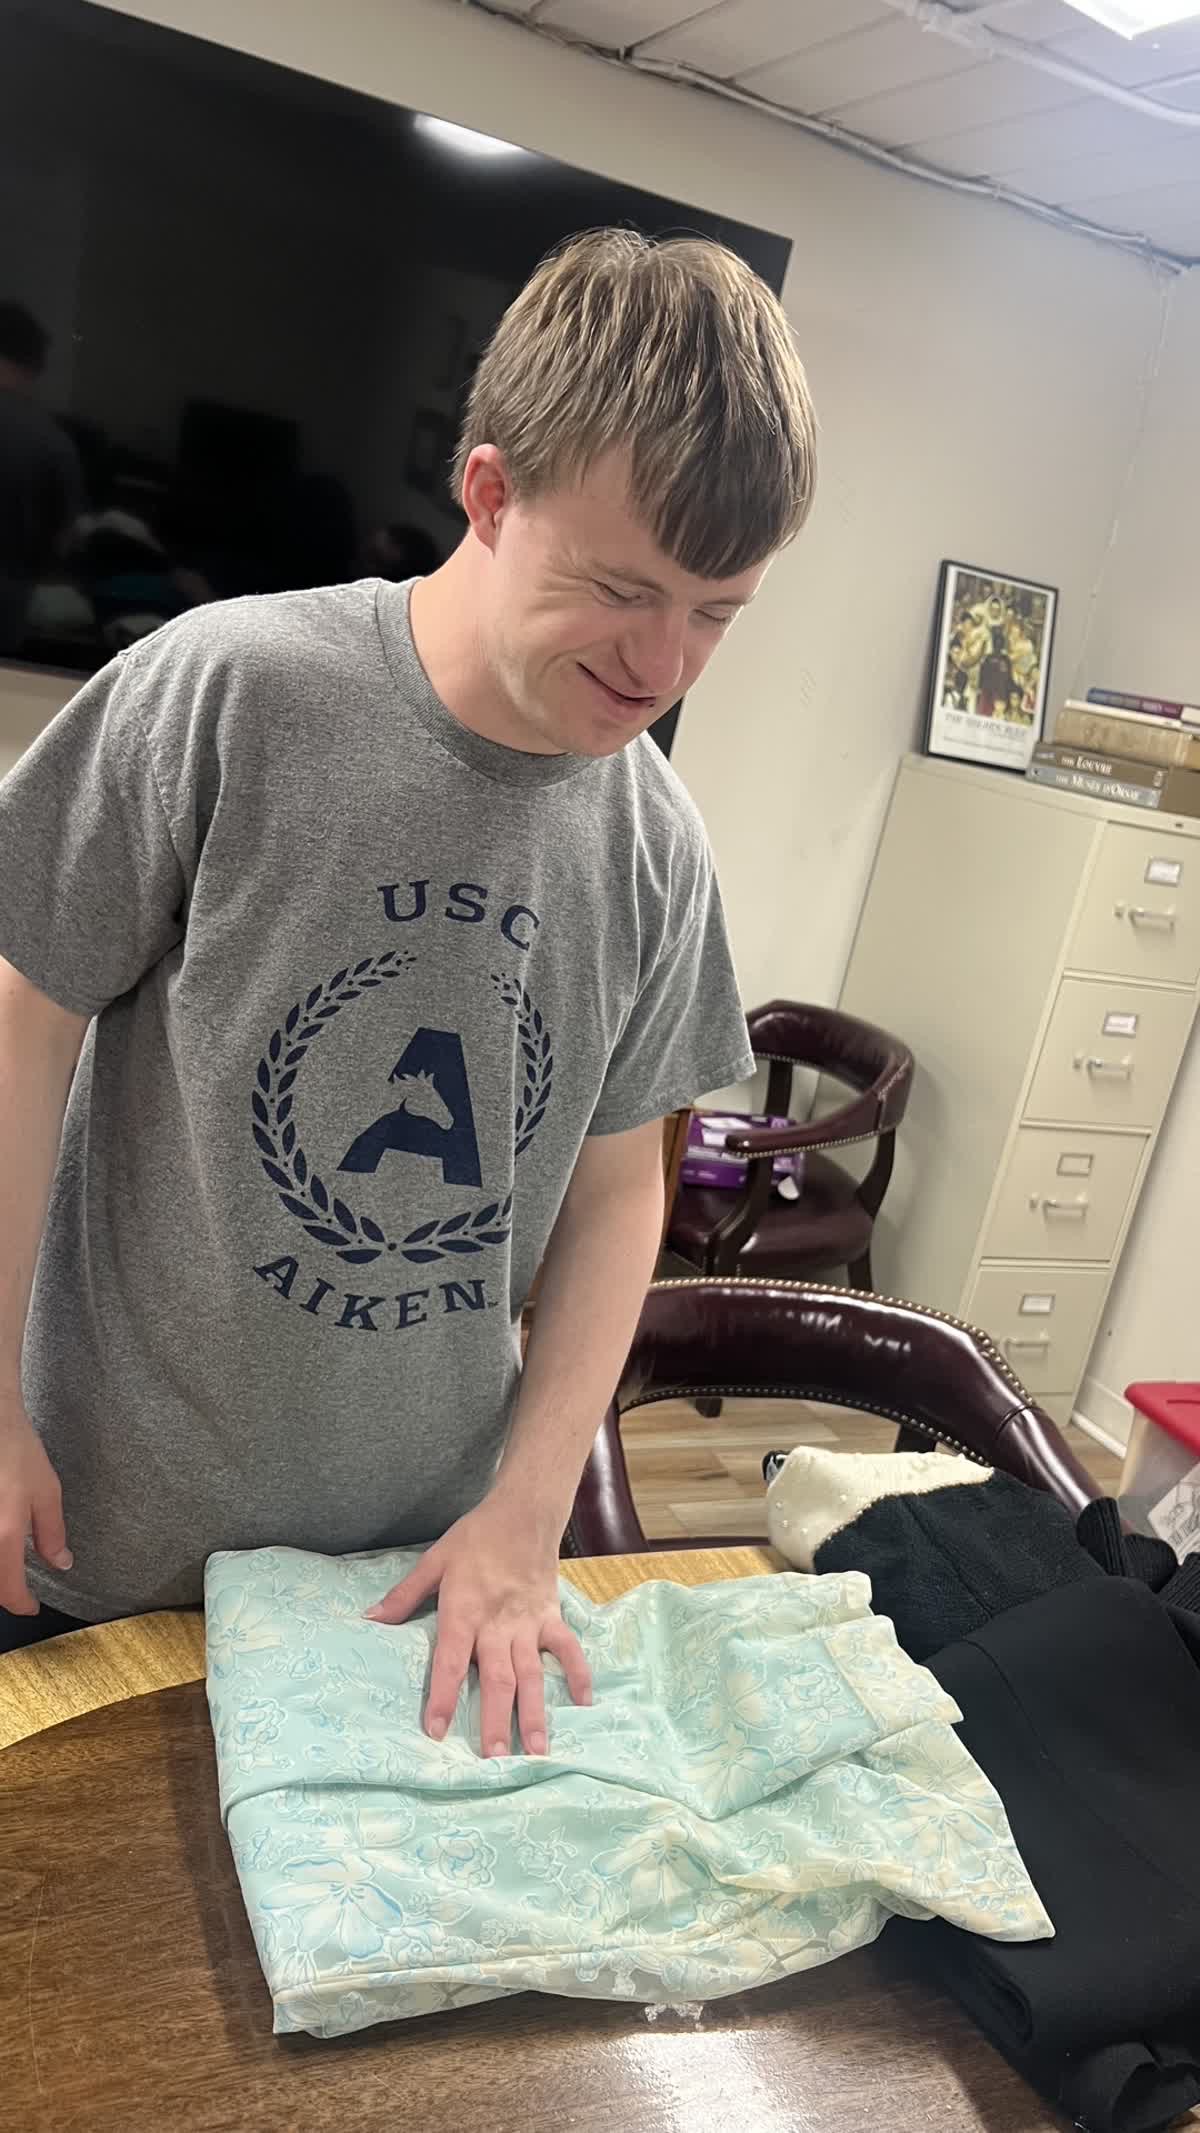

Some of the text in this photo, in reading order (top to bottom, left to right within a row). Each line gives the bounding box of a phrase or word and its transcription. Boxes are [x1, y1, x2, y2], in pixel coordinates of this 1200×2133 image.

[377, 879, 541, 950] USC
[336, 1026, 483, 1188] A
[253, 1254, 485, 1332] AIKEN
